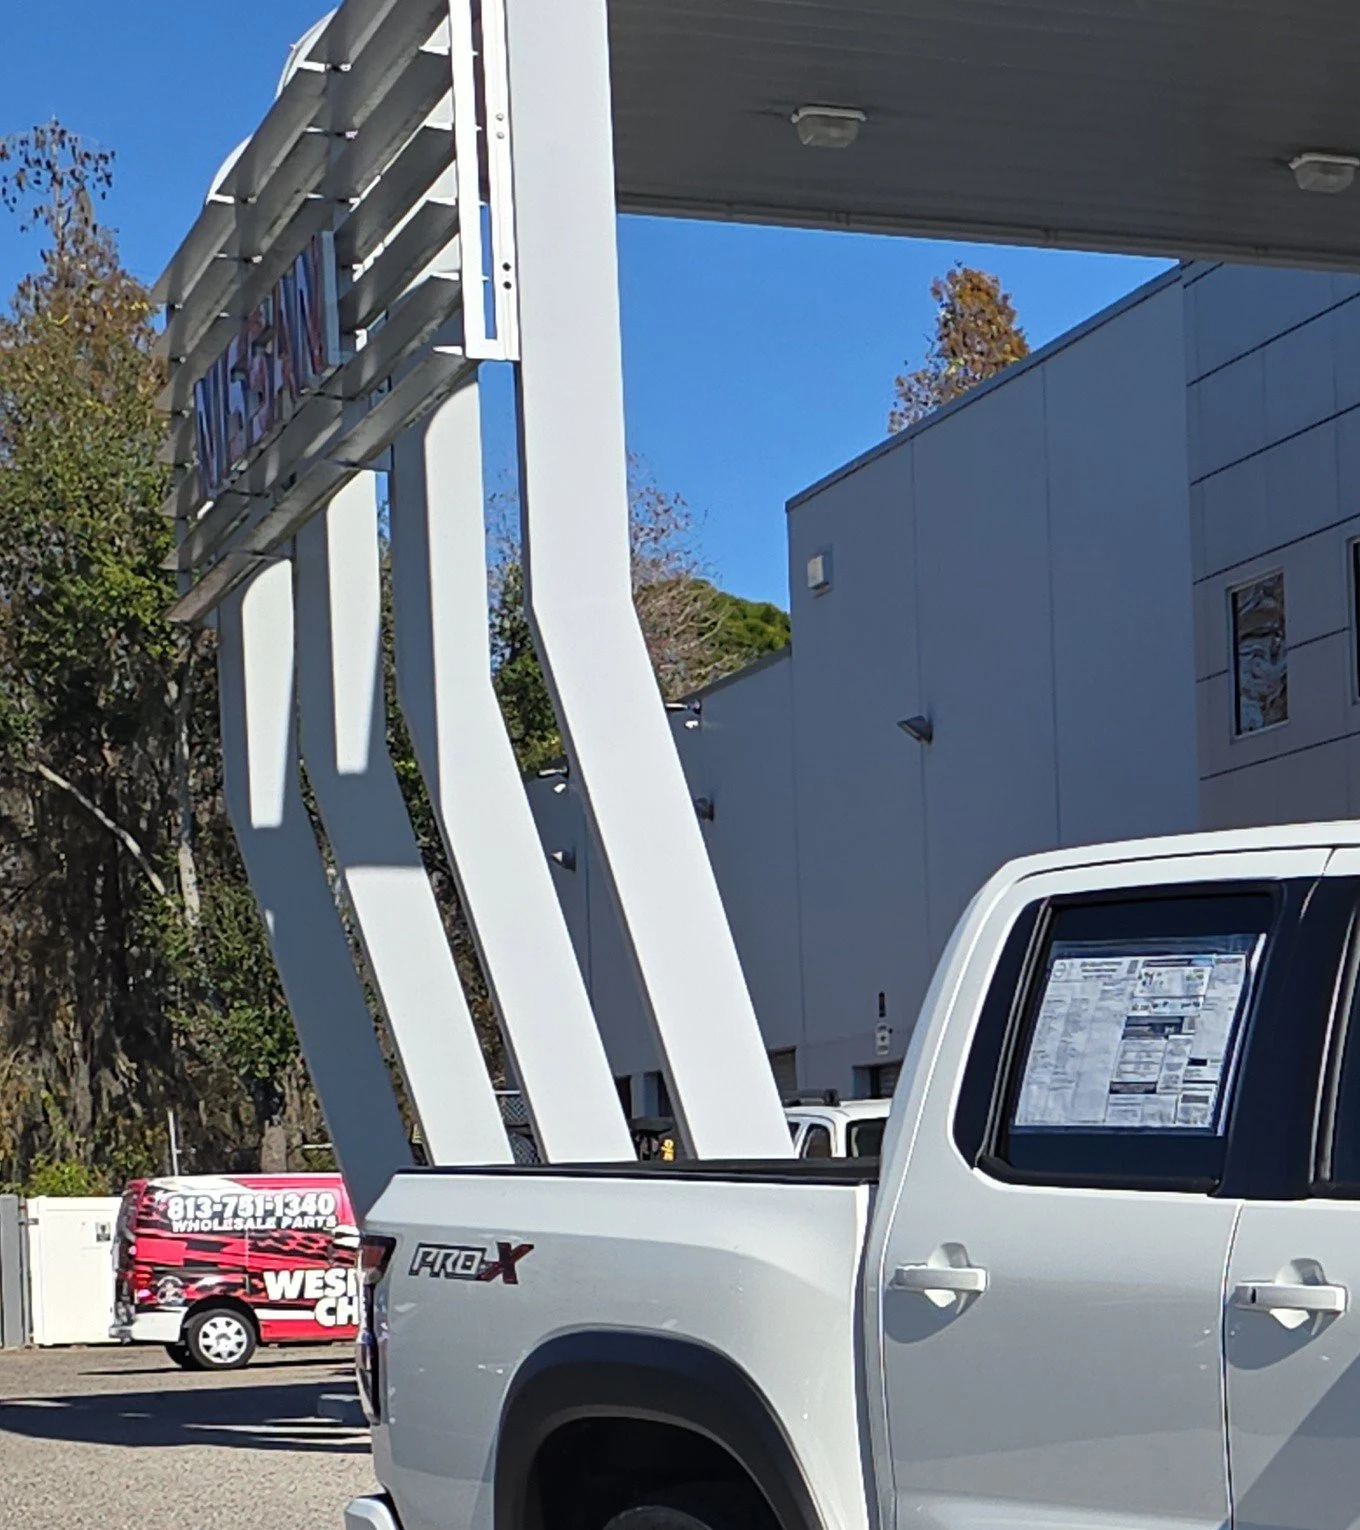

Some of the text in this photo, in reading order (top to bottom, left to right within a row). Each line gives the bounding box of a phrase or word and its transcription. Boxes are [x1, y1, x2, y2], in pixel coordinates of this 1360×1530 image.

[166, 1192, 337, 1220] 813-751-1340
[171, 1214, 338, 1233] WHOLESALE PARTS
